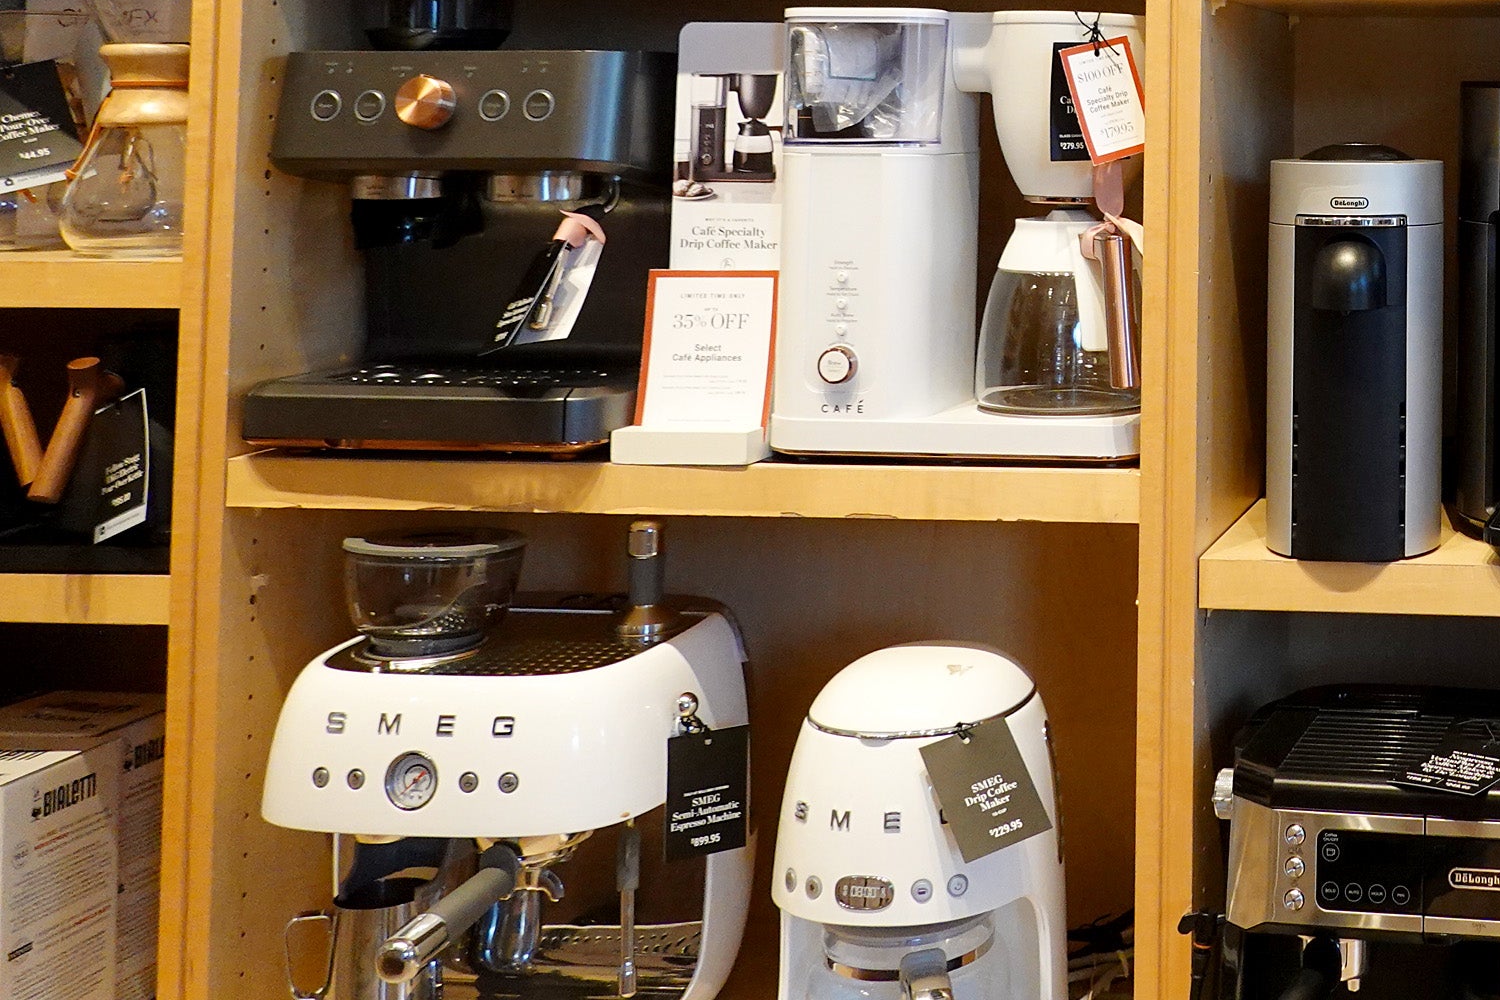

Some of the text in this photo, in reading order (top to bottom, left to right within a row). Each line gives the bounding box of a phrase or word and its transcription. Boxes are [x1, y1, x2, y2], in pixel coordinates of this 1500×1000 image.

[1076, 62, 1124, 84] $100 OFF
[1086, 90, 1129, 107] Specialty Drip
[1097, 86, 1113, 95] Café
[1089, 99, 1130, 114] Coffee Maker
[1060, 141, 1084, 150] $279.95
[691, 226, 766, 239] Café Specialty
[680, 239, 778, 250] Drip Coffee Maker
[673, 313, 750, 329] 35% OFF
[694, 343, 722, 352] Select
[672, 353, 743, 363] Café Appliances
[821, 399, 864, 414] CAFÉ
[326, 711, 516, 738] SMEG
[971, 774, 1003, 794] SMEG
[692, 793, 721, 807] SMEG
[964, 781, 1018, 807] Drip Coffee
[672, 800, 740, 822] Semi-Automatic
[979, 794, 1011, 812] Maker
[670, 811, 742, 833] Espresso Machine
[989, 818, 1023, 838] $229.95
